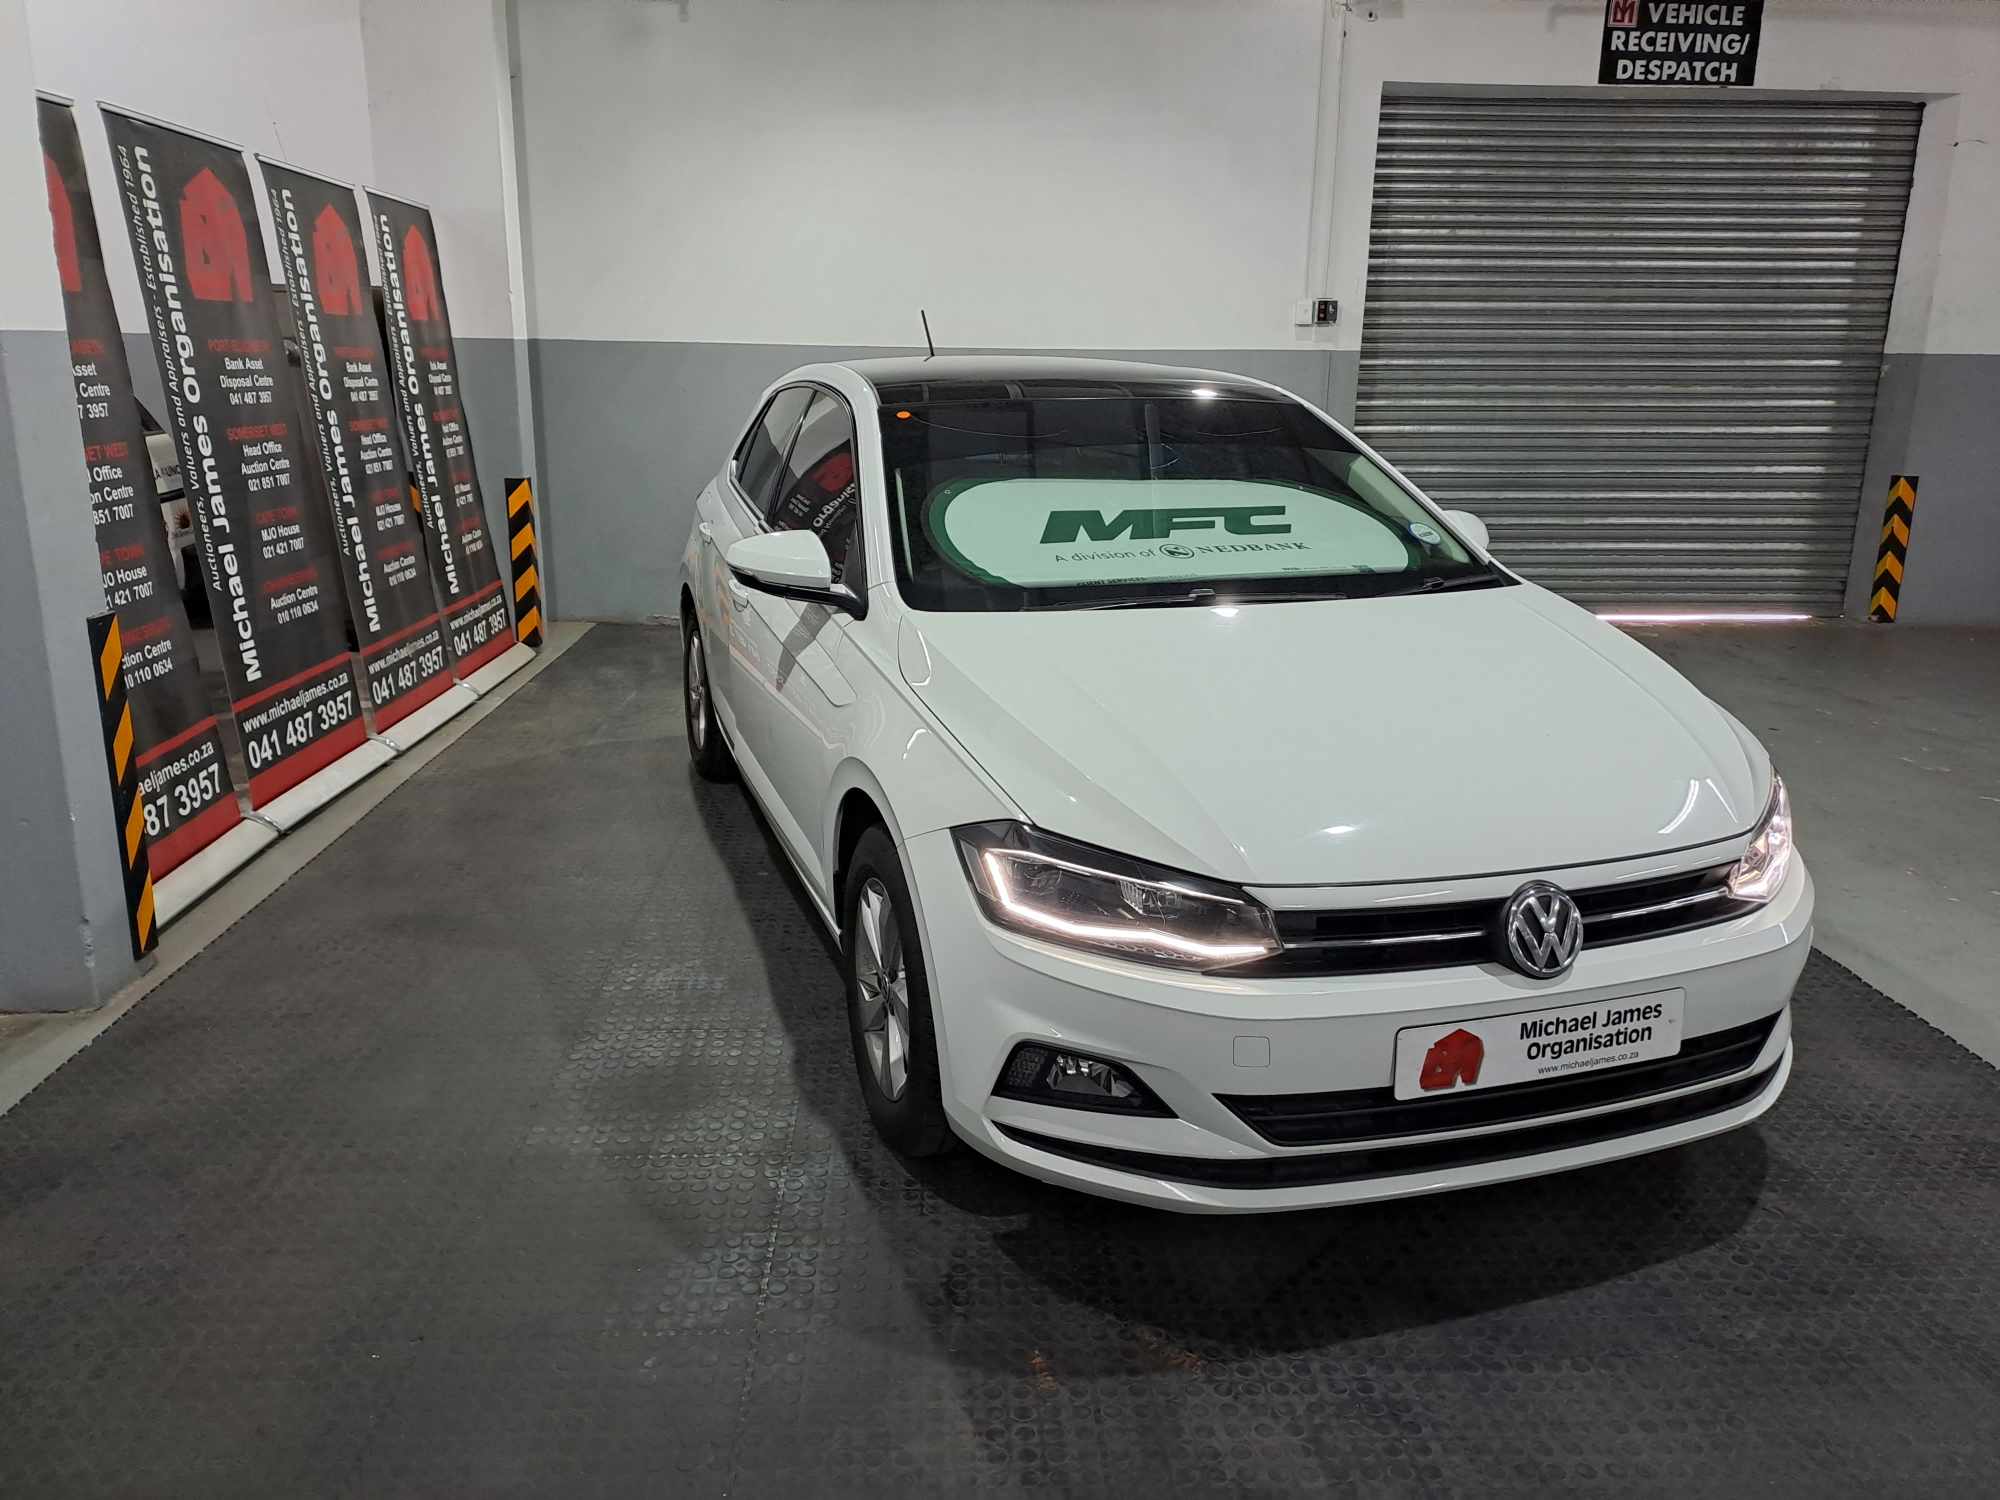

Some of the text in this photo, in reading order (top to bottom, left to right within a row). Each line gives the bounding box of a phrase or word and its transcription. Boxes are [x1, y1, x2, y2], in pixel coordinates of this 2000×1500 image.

[1648, 3, 1746, 26] VEHICLE
[1610, 30, 1750, 55] RECEIVING/
[1616, 59, 1738, 83] DESPATCH
[117, 144, 134, 187] 1964
[127, 191, 157, 290] Established
[379, 214, 419, 395] Organisation
[153, 305, 180, 392] Appraisers
[224, 357, 245, 370] Bank
[79, 382, 111, 398] Centre
[219, 374, 253, 390] Disposal
[86, 402, 109, 419] 3957
[134, 145, 263, 682] Michael James Organisation
[171, 395, 187, 427] and
[281, 188, 381, 632] Michael James Organisation
[181, 431, 200, 490] Valuers
[242, 442, 262, 457] Head
[414, 402, 438, 488] James
[93, 465, 123, 482] Office
[241, 460, 269, 475] Auction
[247, 478, 262, 492] 021
[261, 475, 275, 489] 851
[103, 484, 134, 502] Centre
[112, 503, 134, 521] 7007
[1040, 505, 1292, 544] MFC
[196, 496, 223, 592] Auctioneers,
[277, 524, 301, 538] House
[430, 494, 460, 594] Michael
[275, 541, 289, 555] 421
[1055, 541, 1312, 564] A division of NEDBANK
[103, 565, 148, 588] JO House
[114, 587, 132, 606] 421
[132, 581, 153, 600] 7007
[453, 608, 506, 656] 041 487 3957
[121, 639, 172, 669] tion Centre
[124, 657, 173, 689] 10 110 0634
[372, 645, 443, 705] 041 487 3957
[242, 672, 349, 734] www.michaeljames.co.za
[248, 690, 353, 769] 041 487 3957
[138, 741, 214, 797] aeljames.co.za
[143, 762, 221, 836] 87 3957
[1519, 1003, 1663, 1041] Michael James
[1526, 1024, 1652, 1061] Organisation
[1537, 1051, 1639, 1075] www.michaeljames.co.za
